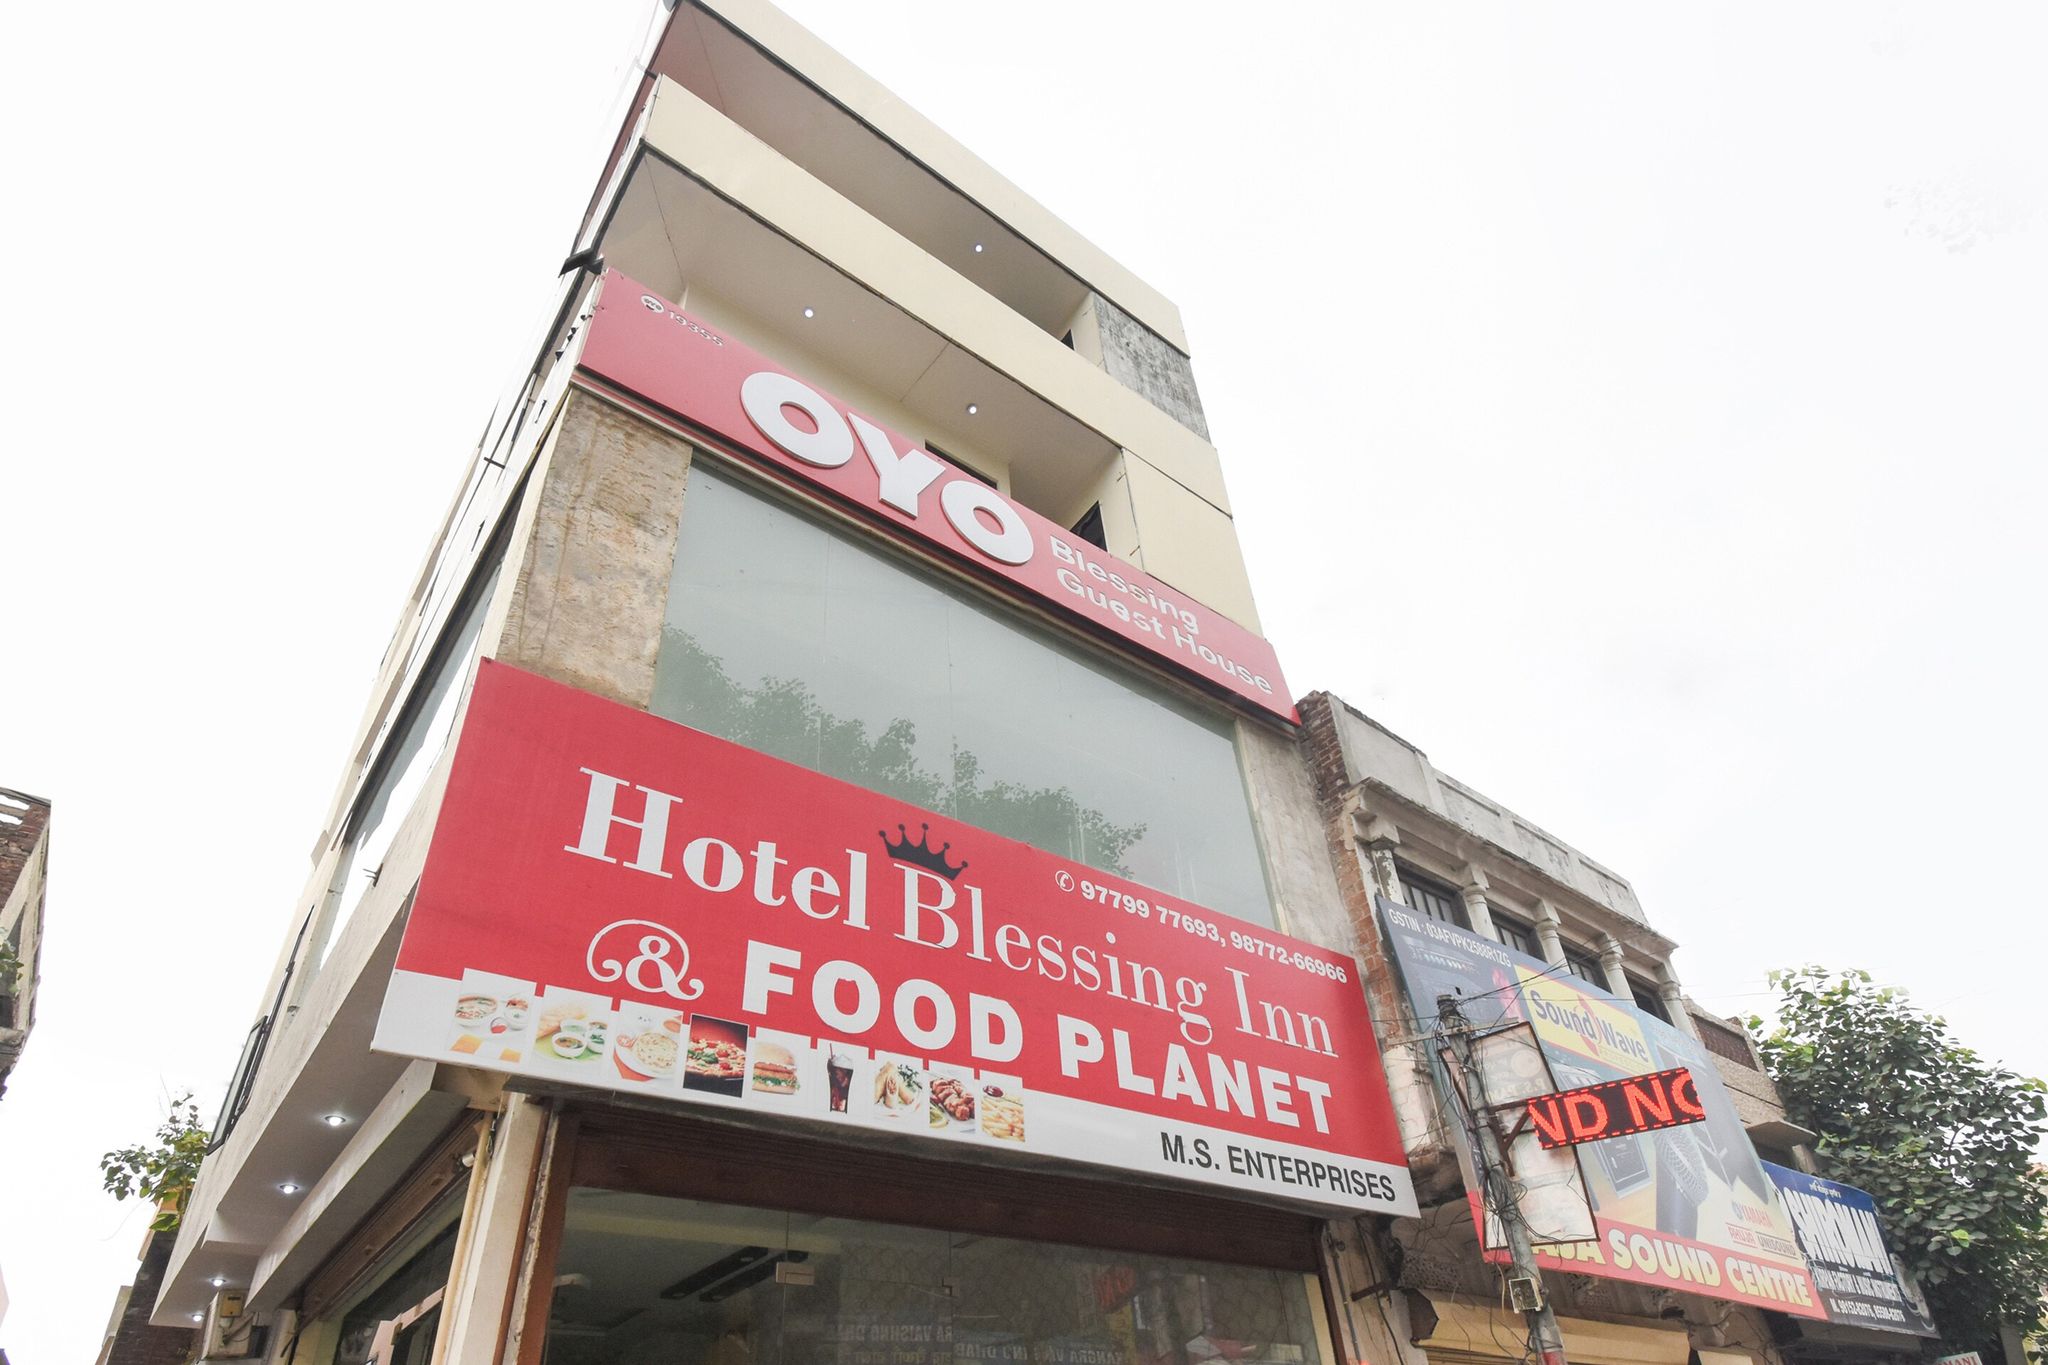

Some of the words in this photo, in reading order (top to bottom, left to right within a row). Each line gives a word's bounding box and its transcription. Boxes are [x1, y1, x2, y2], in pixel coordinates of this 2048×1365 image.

[668, 310, 724, 346] 19355
[740, 371, 1035, 566] OYO
[1050, 535, 1200, 635] Blessing
[1056, 567, 1167, 640] Guest
[1171, 625, 1273, 695] House
[563, 766, 871, 931] Hotel
[893, 862, 1213, 1045] Blessing
[1224, 966, 1339, 1058] Inn
[1080, 880, 1150, 919] 97799
[1155, 905, 1227, 947] 77693,
[1230, 931, 1348, 984] 98772-66966
[1388, 908, 1421, 932] GSTIN
[586, 918, 704, 1000] &
[742, 940, 1023, 1063] FOOD
[1056, 1014, 1333, 1135] PLANET
[1530, 989, 1597, 1040] Sound
[1597, 1017, 1649, 1063] Wave
[1160, 1131, 1220, 1170] M.S.
[1228, 1146, 1396, 1203] ENTERPRISES
[1608, 1228, 1721, 1288] SOUND
[1724, 1256, 1813, 1307] CENTRE
